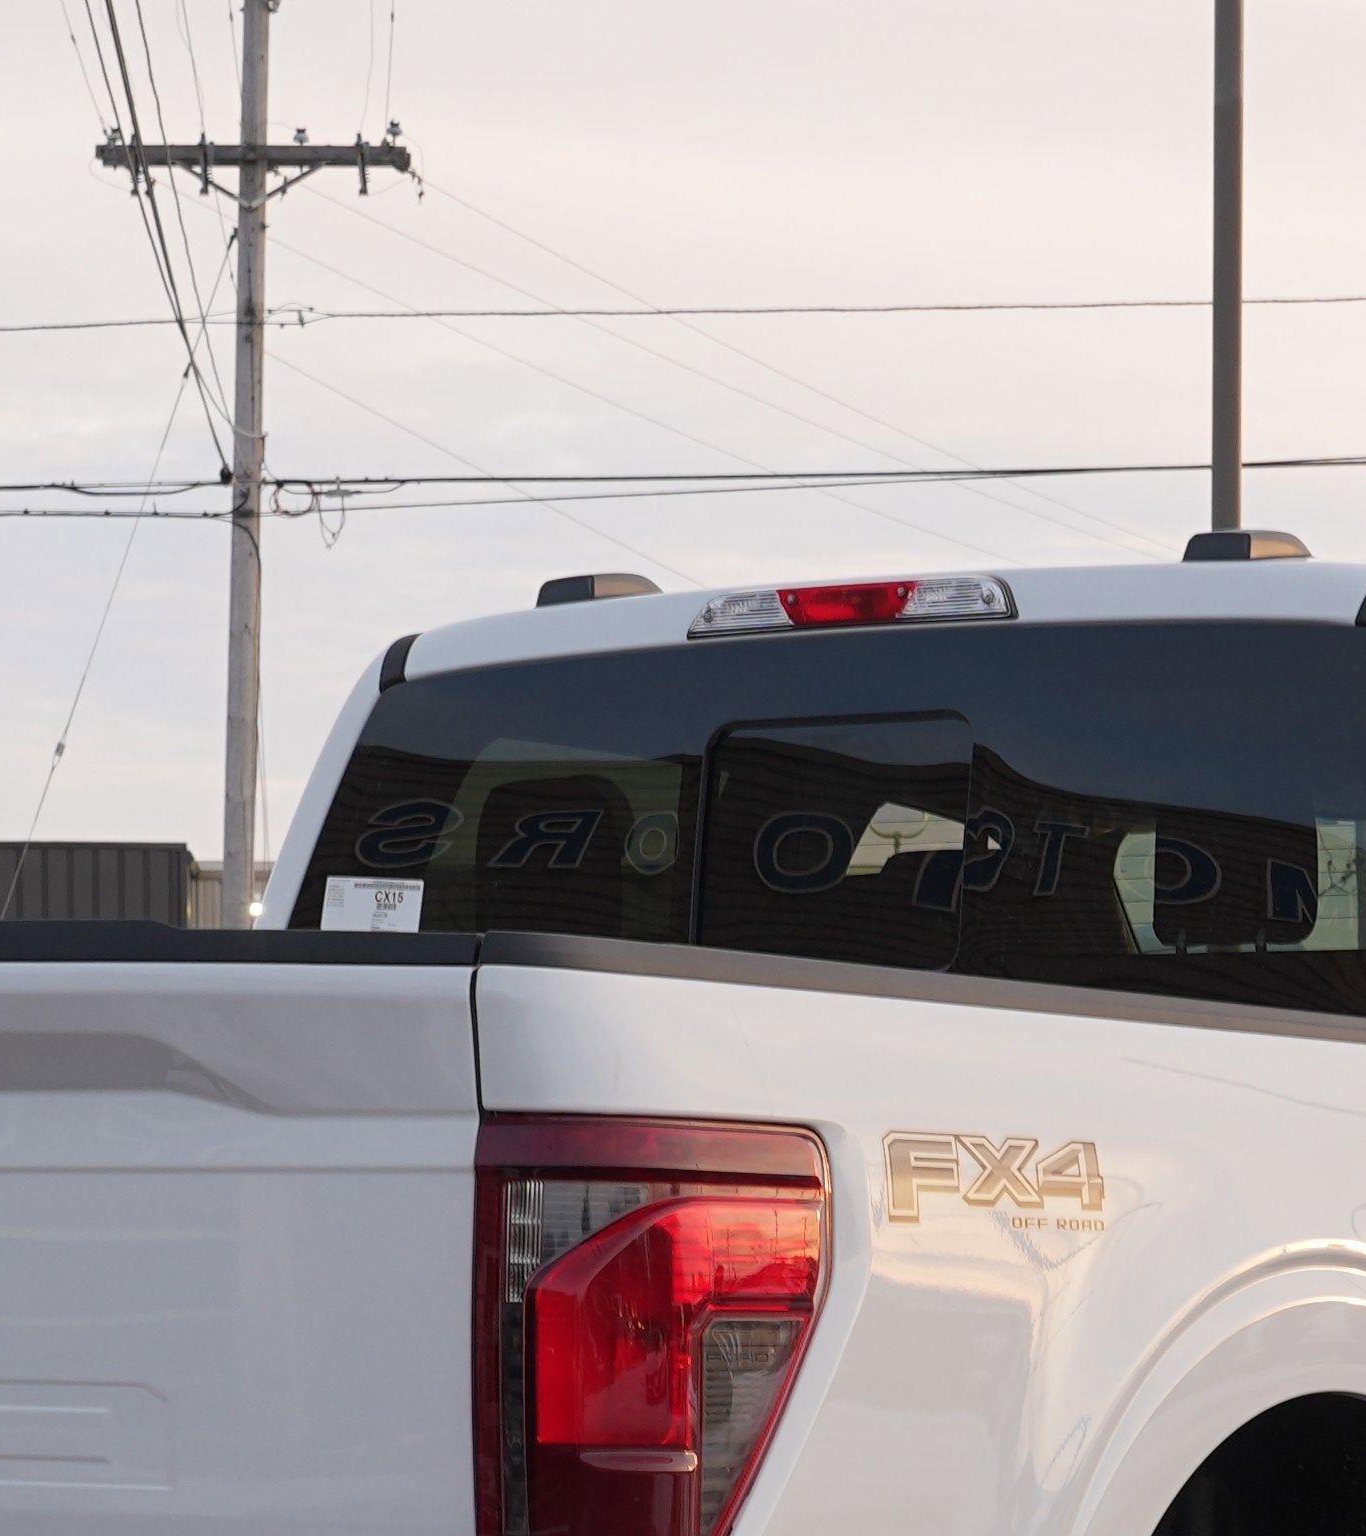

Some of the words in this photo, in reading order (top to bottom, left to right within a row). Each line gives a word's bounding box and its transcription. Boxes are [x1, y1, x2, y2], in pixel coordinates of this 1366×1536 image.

[375, 890, 404, 904] CX15
[883, 1131, 1105, 1224] FX4
[1011, 1216, 1049, 1231] OFF
[1056, 1217, 1105, 1232] ROAD
